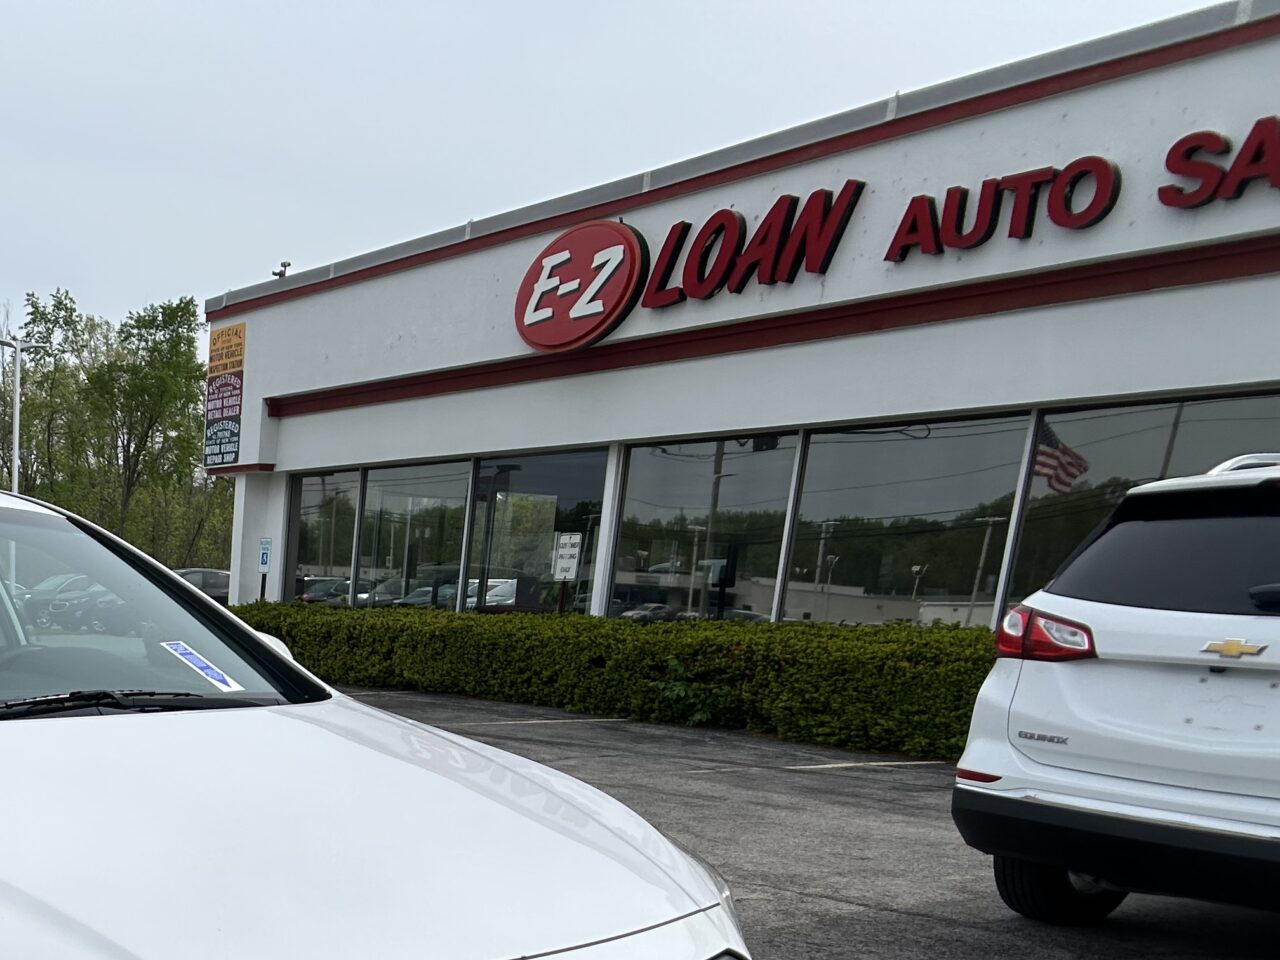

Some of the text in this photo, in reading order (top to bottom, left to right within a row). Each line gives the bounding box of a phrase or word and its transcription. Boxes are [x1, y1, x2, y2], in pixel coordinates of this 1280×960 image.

[524, 245, 624, 326] E-Z
[641, 179, 867, 309] LOAN
[883, 155, 1123, 263] AUTO
[212, 327, 242, 346] OFFICIAL
[224, 346, 242, 360] VEHICLE
[209, 373, 241, 394] REGISTERED
[223, 394, 240, 407] VEHICLE
[223, 405, 239, 417] DEALER
[207, 420, 239, 438] REGISTERED
[205, 442, 238, 454] MOTOR VEHICLE
[207, 452, 235, 464] REPAIR SHOP
[1018, 730, 1070, 745] EQUINOX
